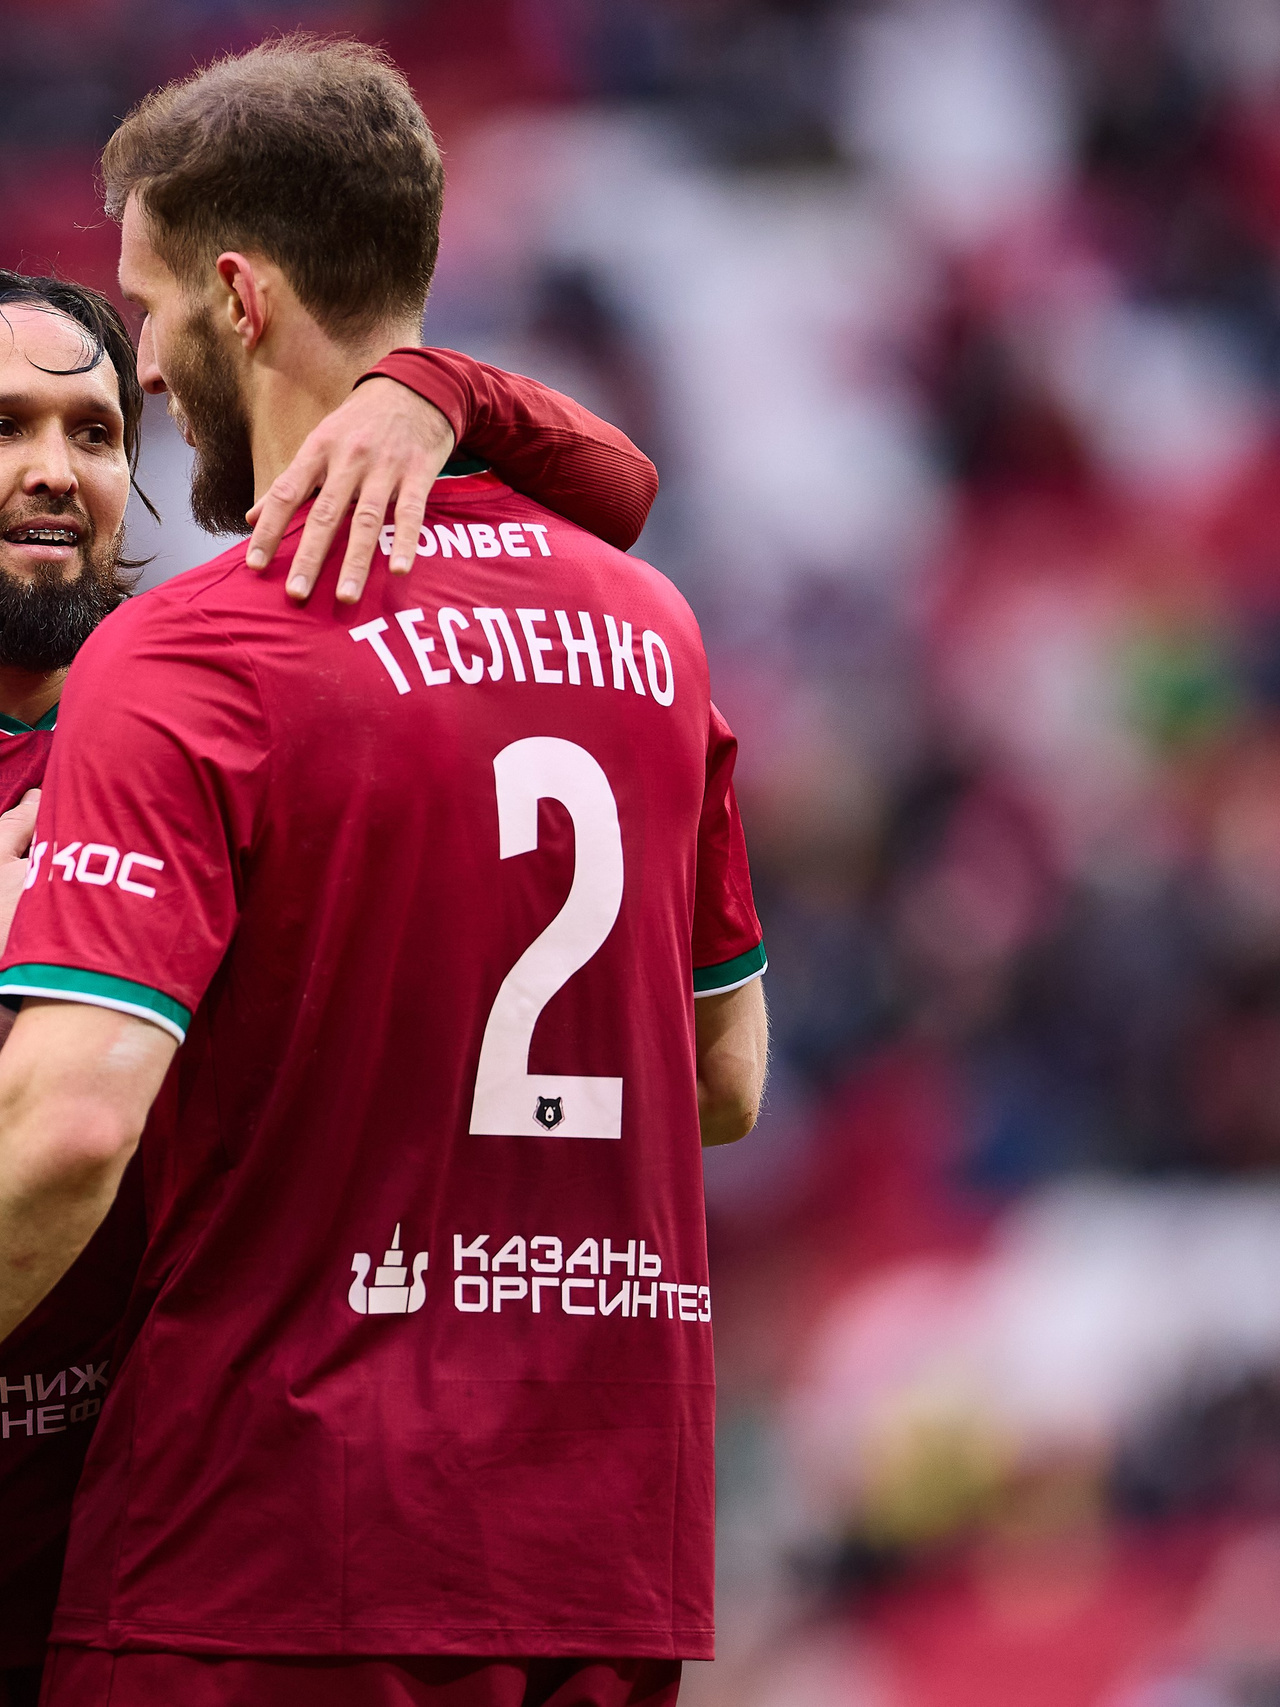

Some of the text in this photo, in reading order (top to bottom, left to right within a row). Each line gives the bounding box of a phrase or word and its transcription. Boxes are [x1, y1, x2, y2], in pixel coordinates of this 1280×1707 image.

[378, 523, 551, 558] FONBET
[348, 606, 675, 707] ТЕСЛЕНКО
[469, 736, 624, 1140] 2
[453, 1234, 662, 1278] КАЗАНЬ
[454, 1275, 711, 1323] ОРГСИНТЕЗ
